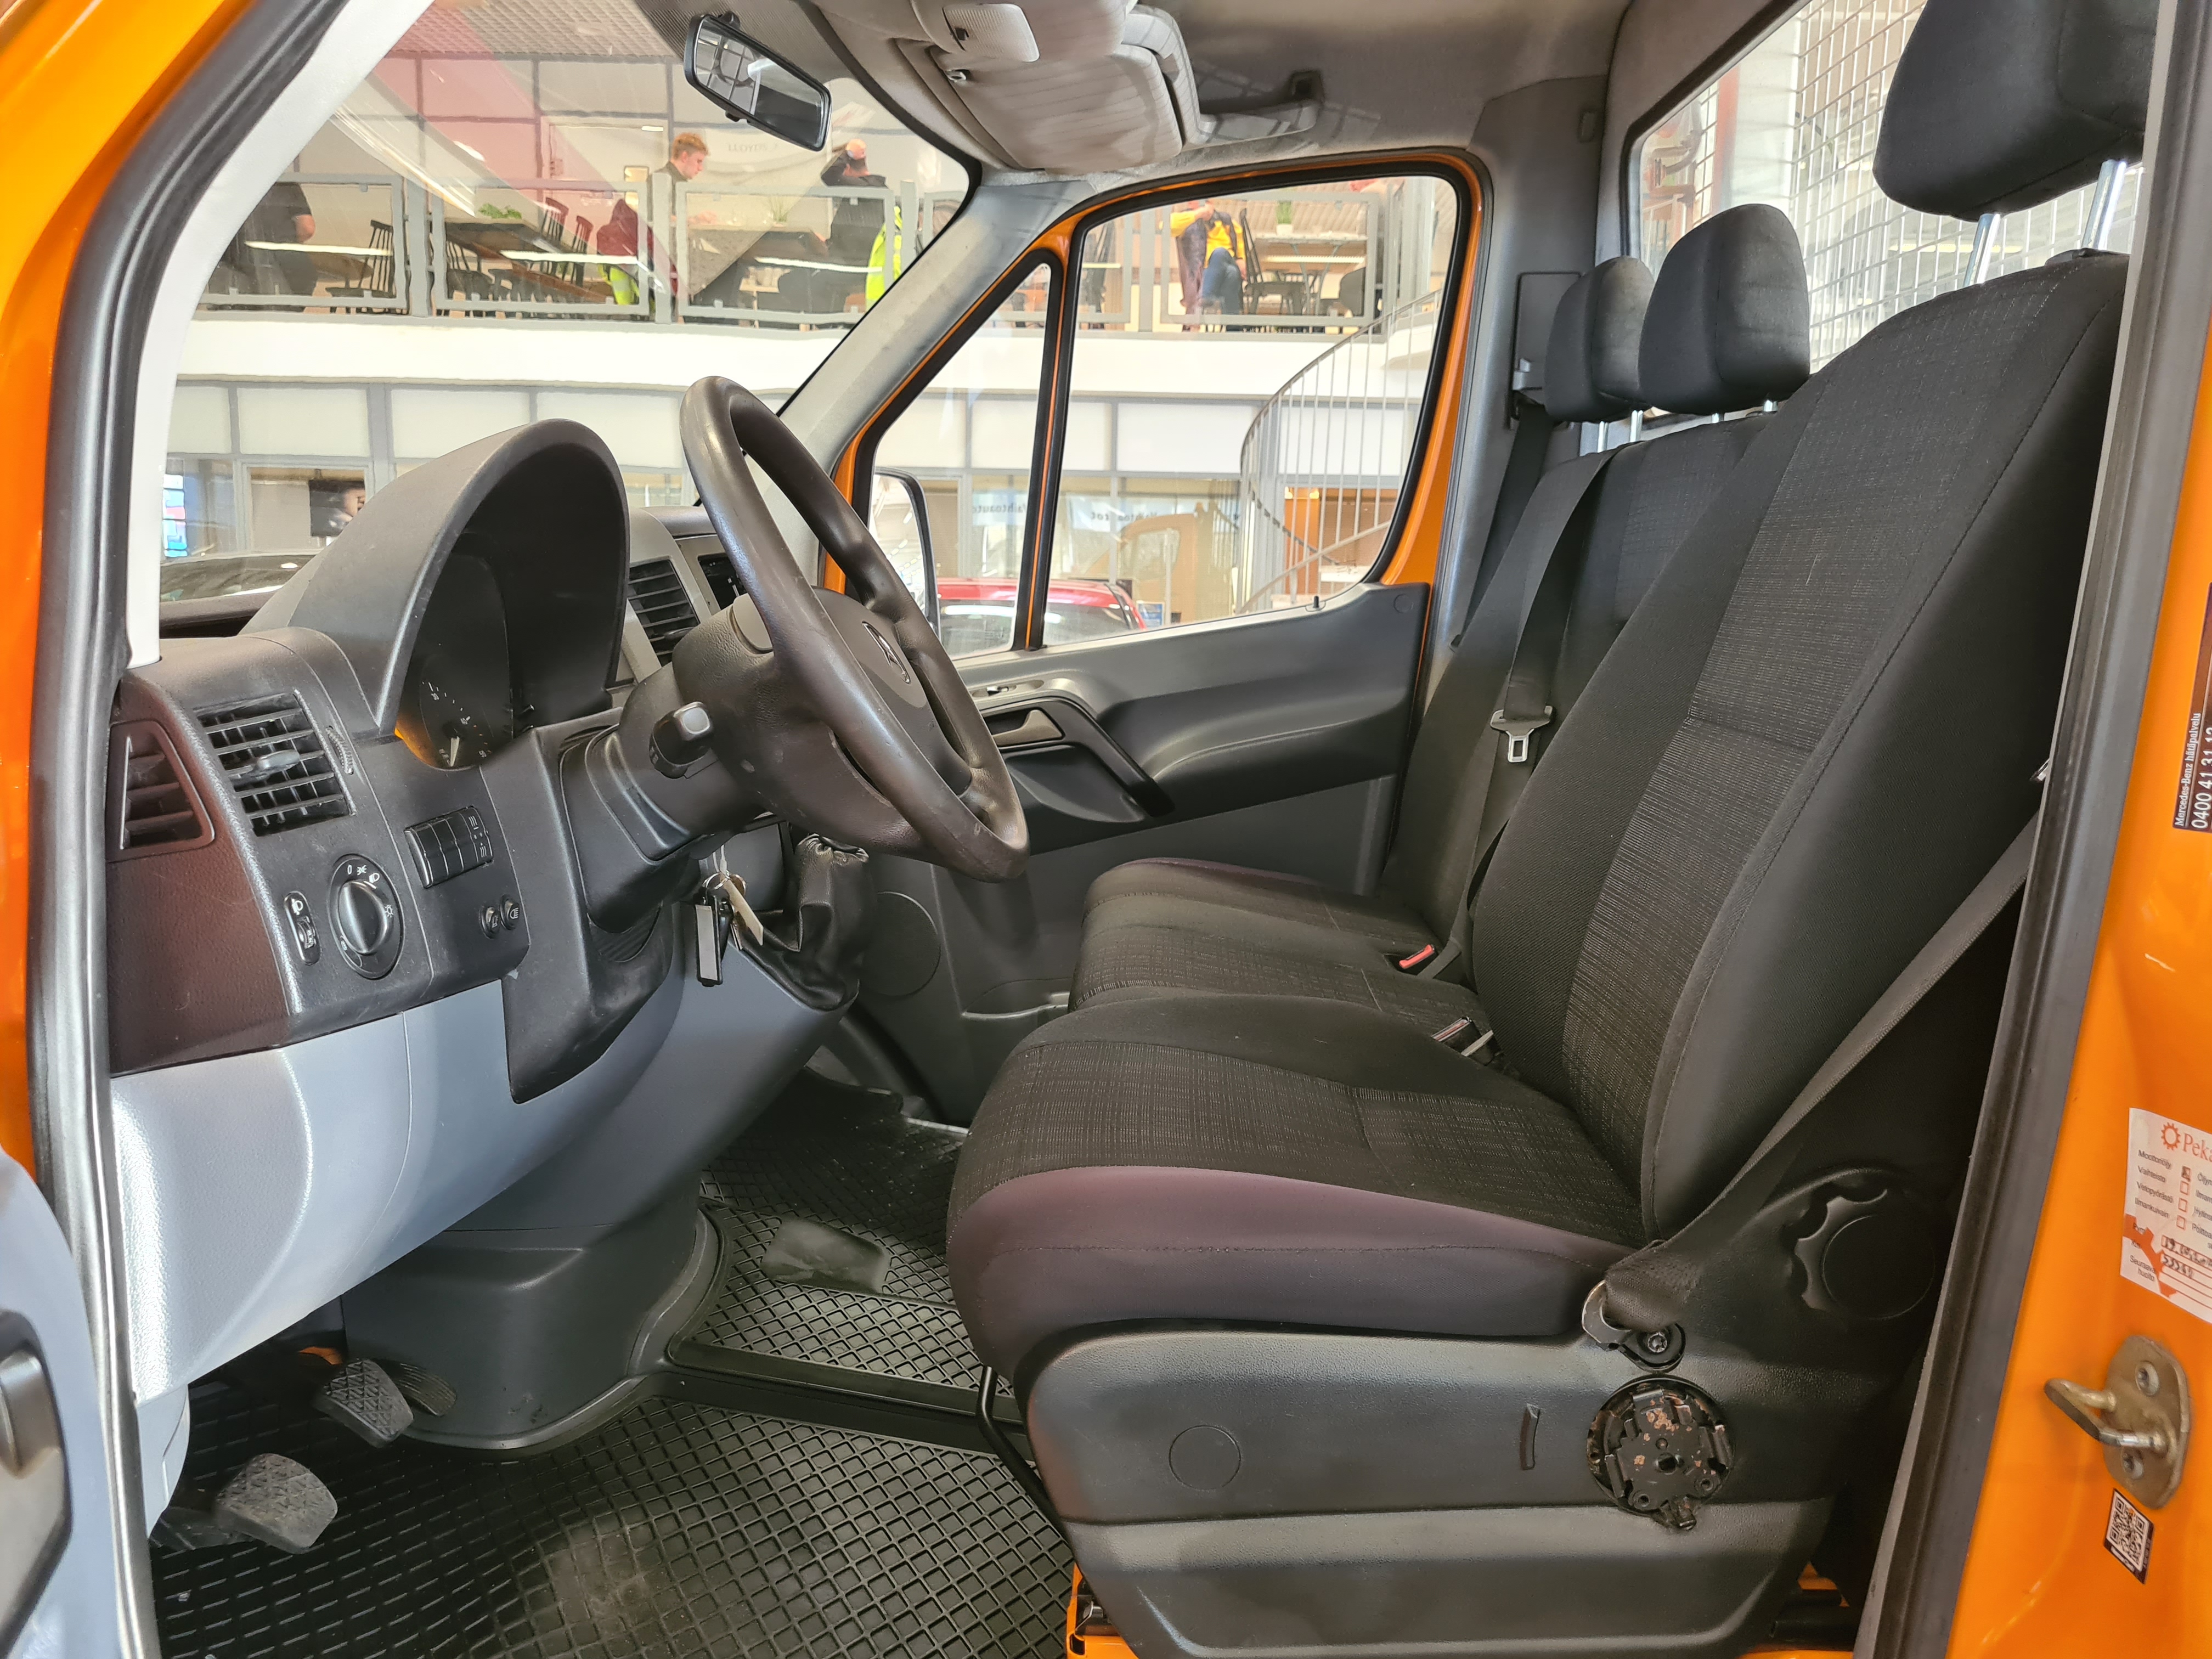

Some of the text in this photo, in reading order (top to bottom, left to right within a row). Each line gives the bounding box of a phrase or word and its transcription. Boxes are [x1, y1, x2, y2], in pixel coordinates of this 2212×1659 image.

[2174, 713, 2202, 827] Mercedes-Benz hätäpalvelu
[2198, 772, 2212, 789] 41
[2191, 793, 2212, 828] 0400
